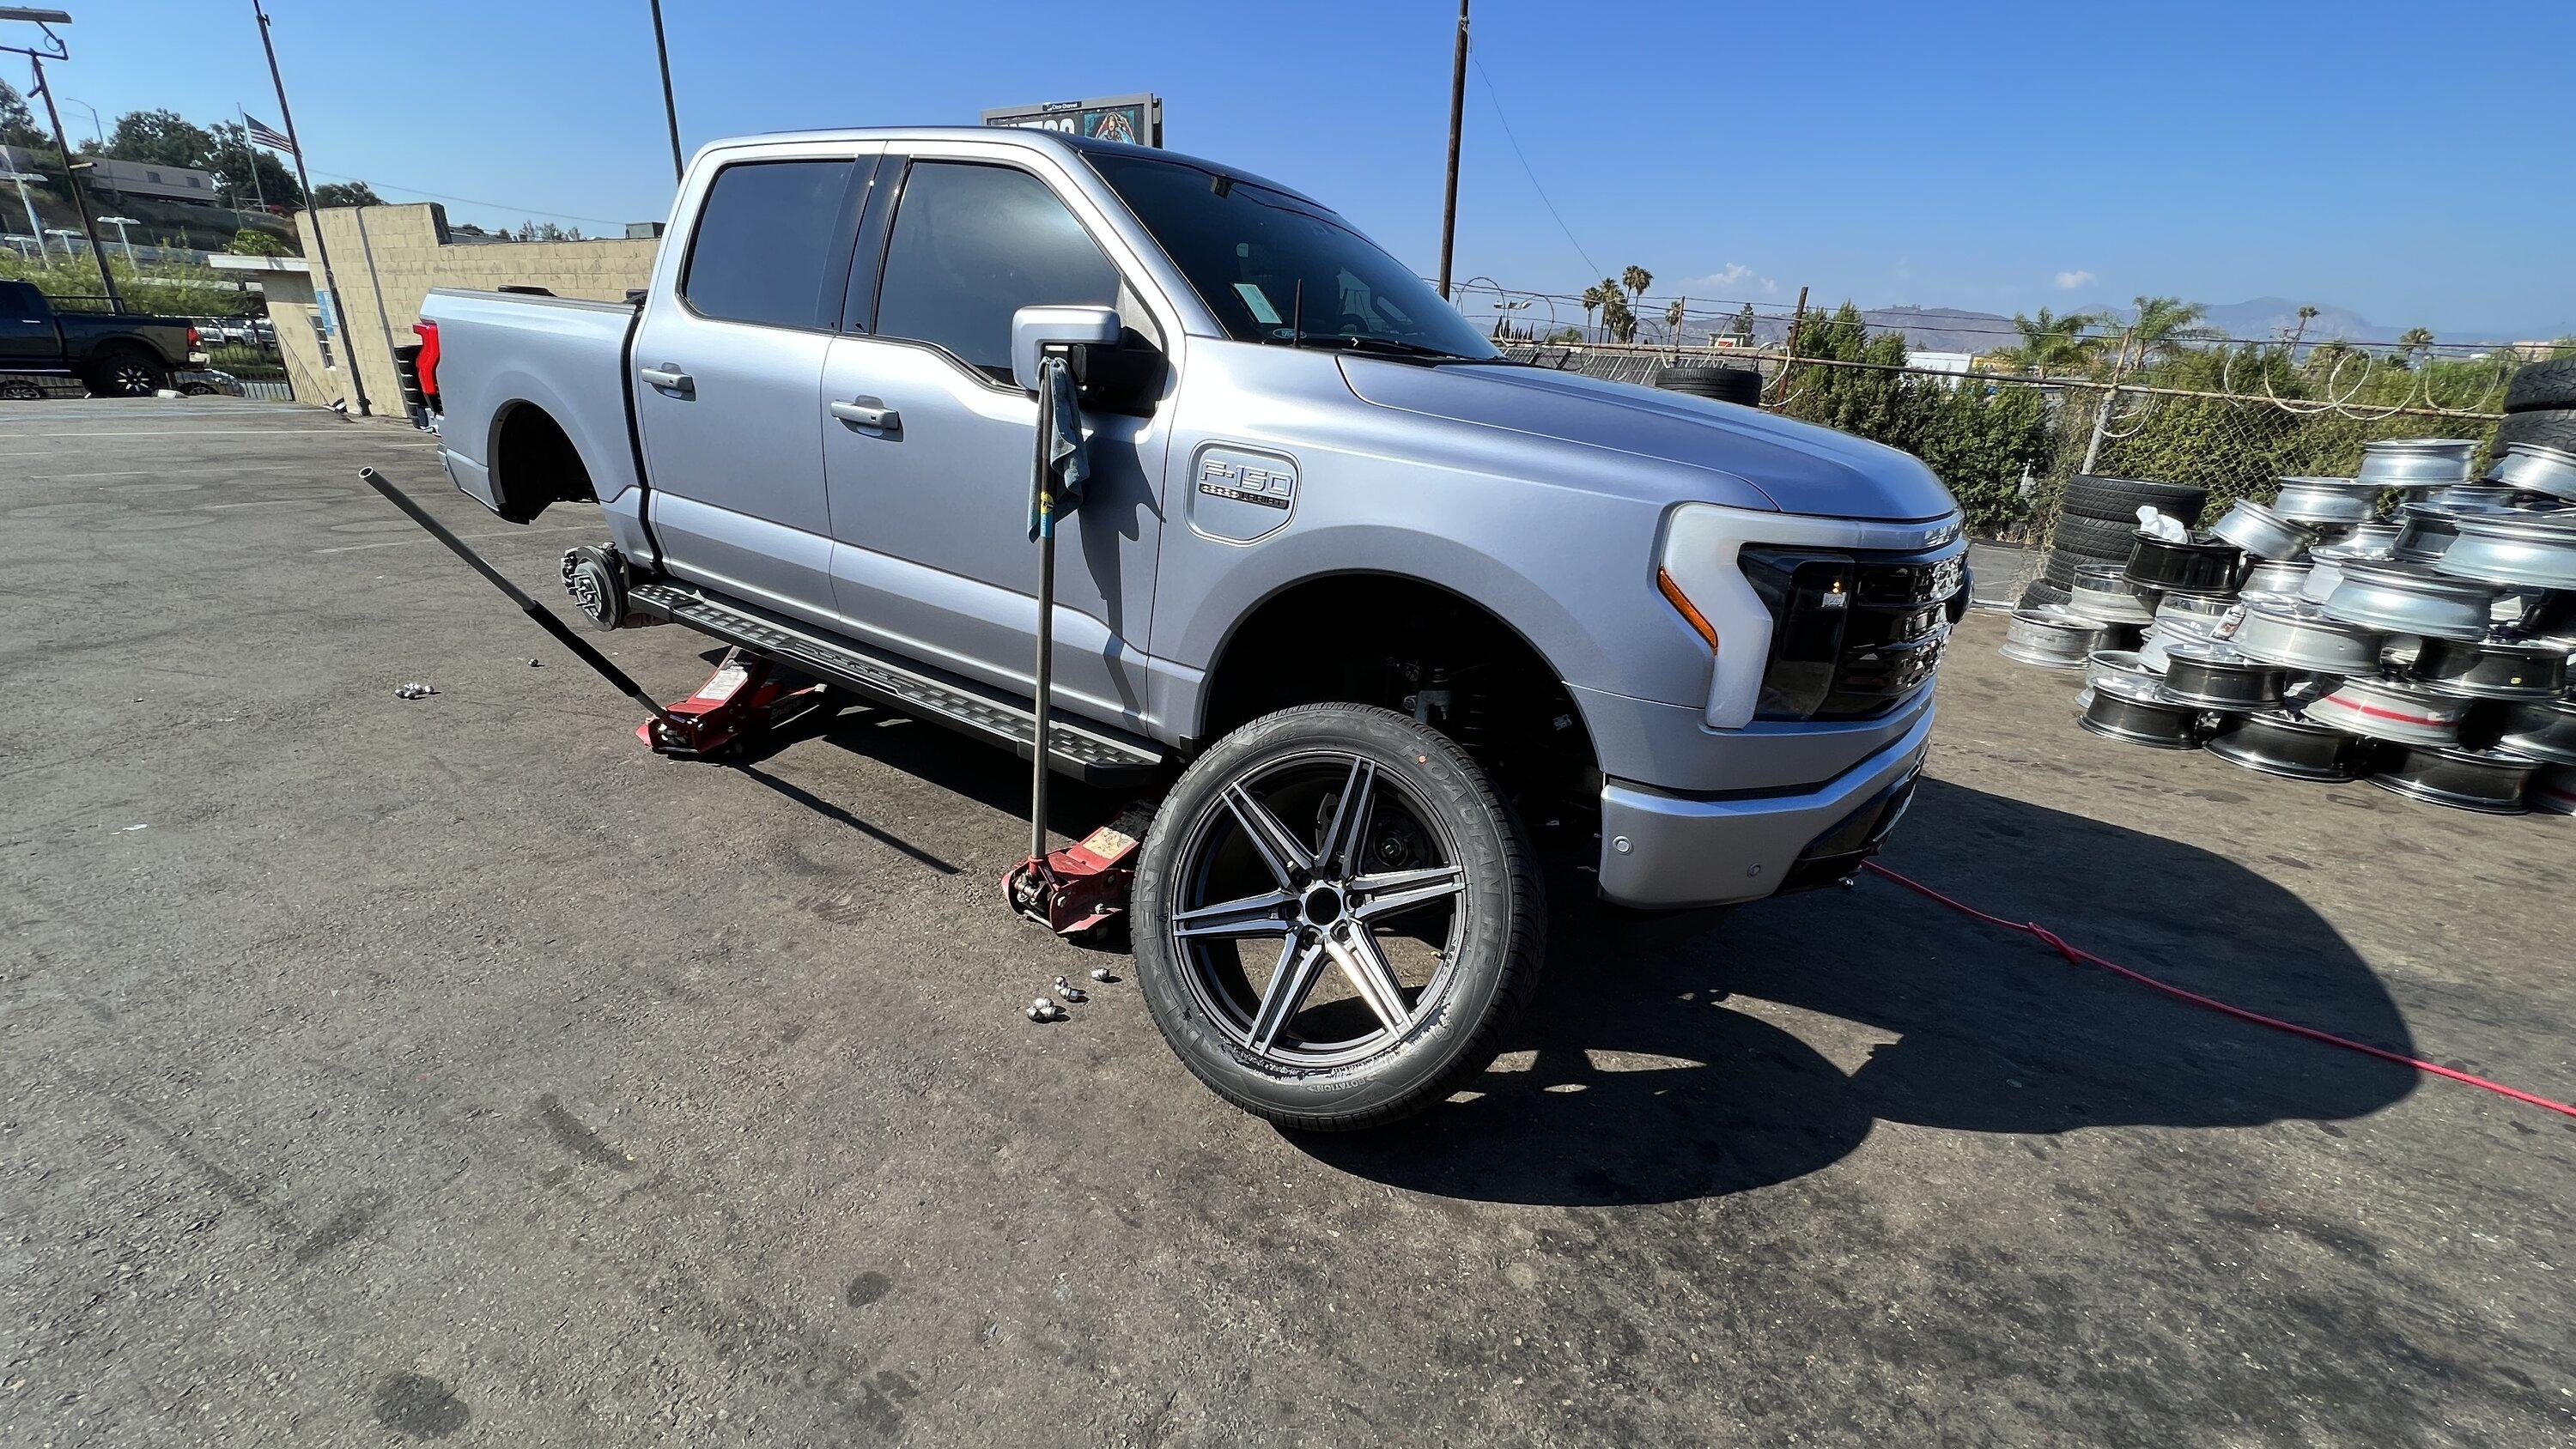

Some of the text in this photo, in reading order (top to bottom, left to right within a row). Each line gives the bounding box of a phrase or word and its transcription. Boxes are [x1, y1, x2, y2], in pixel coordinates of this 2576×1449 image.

[1200, 460, 1292, 497] F-150
[1140, 871, 1200, 1049] NEXEN
[1314, 1078, 1368, 1093] ROTATION
